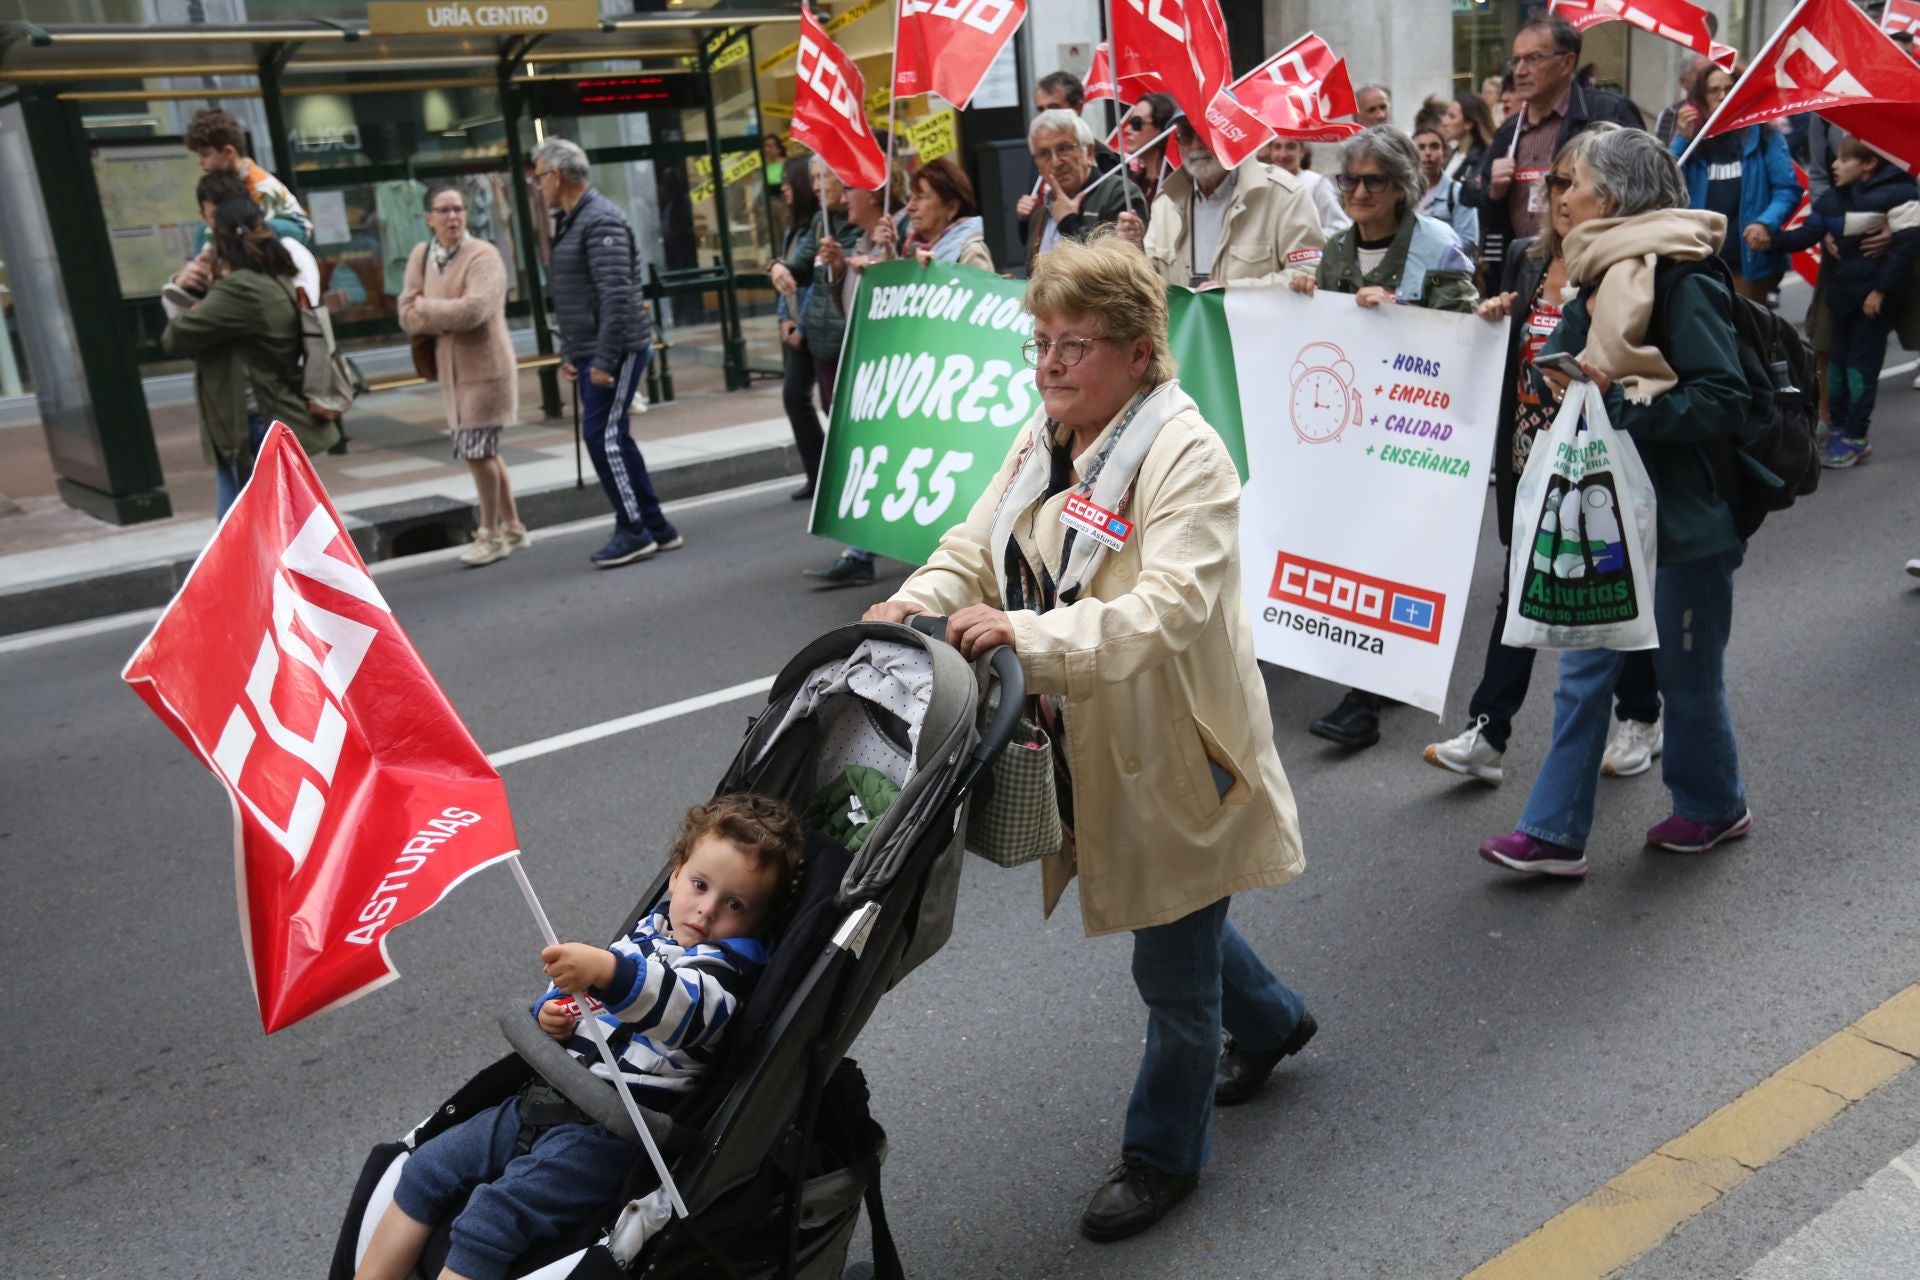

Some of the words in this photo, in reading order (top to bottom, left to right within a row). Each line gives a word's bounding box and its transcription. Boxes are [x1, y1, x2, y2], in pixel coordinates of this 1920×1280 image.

[427, 3, 473, 27] URÍA
[475, 6, 548, 26] CENTRO
[1730, 96, 1840, 126] ASTURIAS
[1393, 353, 1441, 378] HORAS
[851, 352, 1037, 428] MAYORES
[1389, 383, 1451, 410] EMPLEO
[1385, 414, 1453, 441] CALIDAD
[1380, 444, 1471, 478] ENSEÑANZA
[838, 445, 888, 520] DE
[881, 447, 974, 526] 55
[1066, 498, 1108, 527] CCOO
[1091, 529, 1121, 550] Asturias
[1279, 562, 1386, 620] CCOO
[1527, 573, 1630, 607] Asturias
[1576, 601, 1634, 622] natural
[1262, 605, 1385, 656] enseñanza
[344, 807, 482, 945] ASTURIAS
